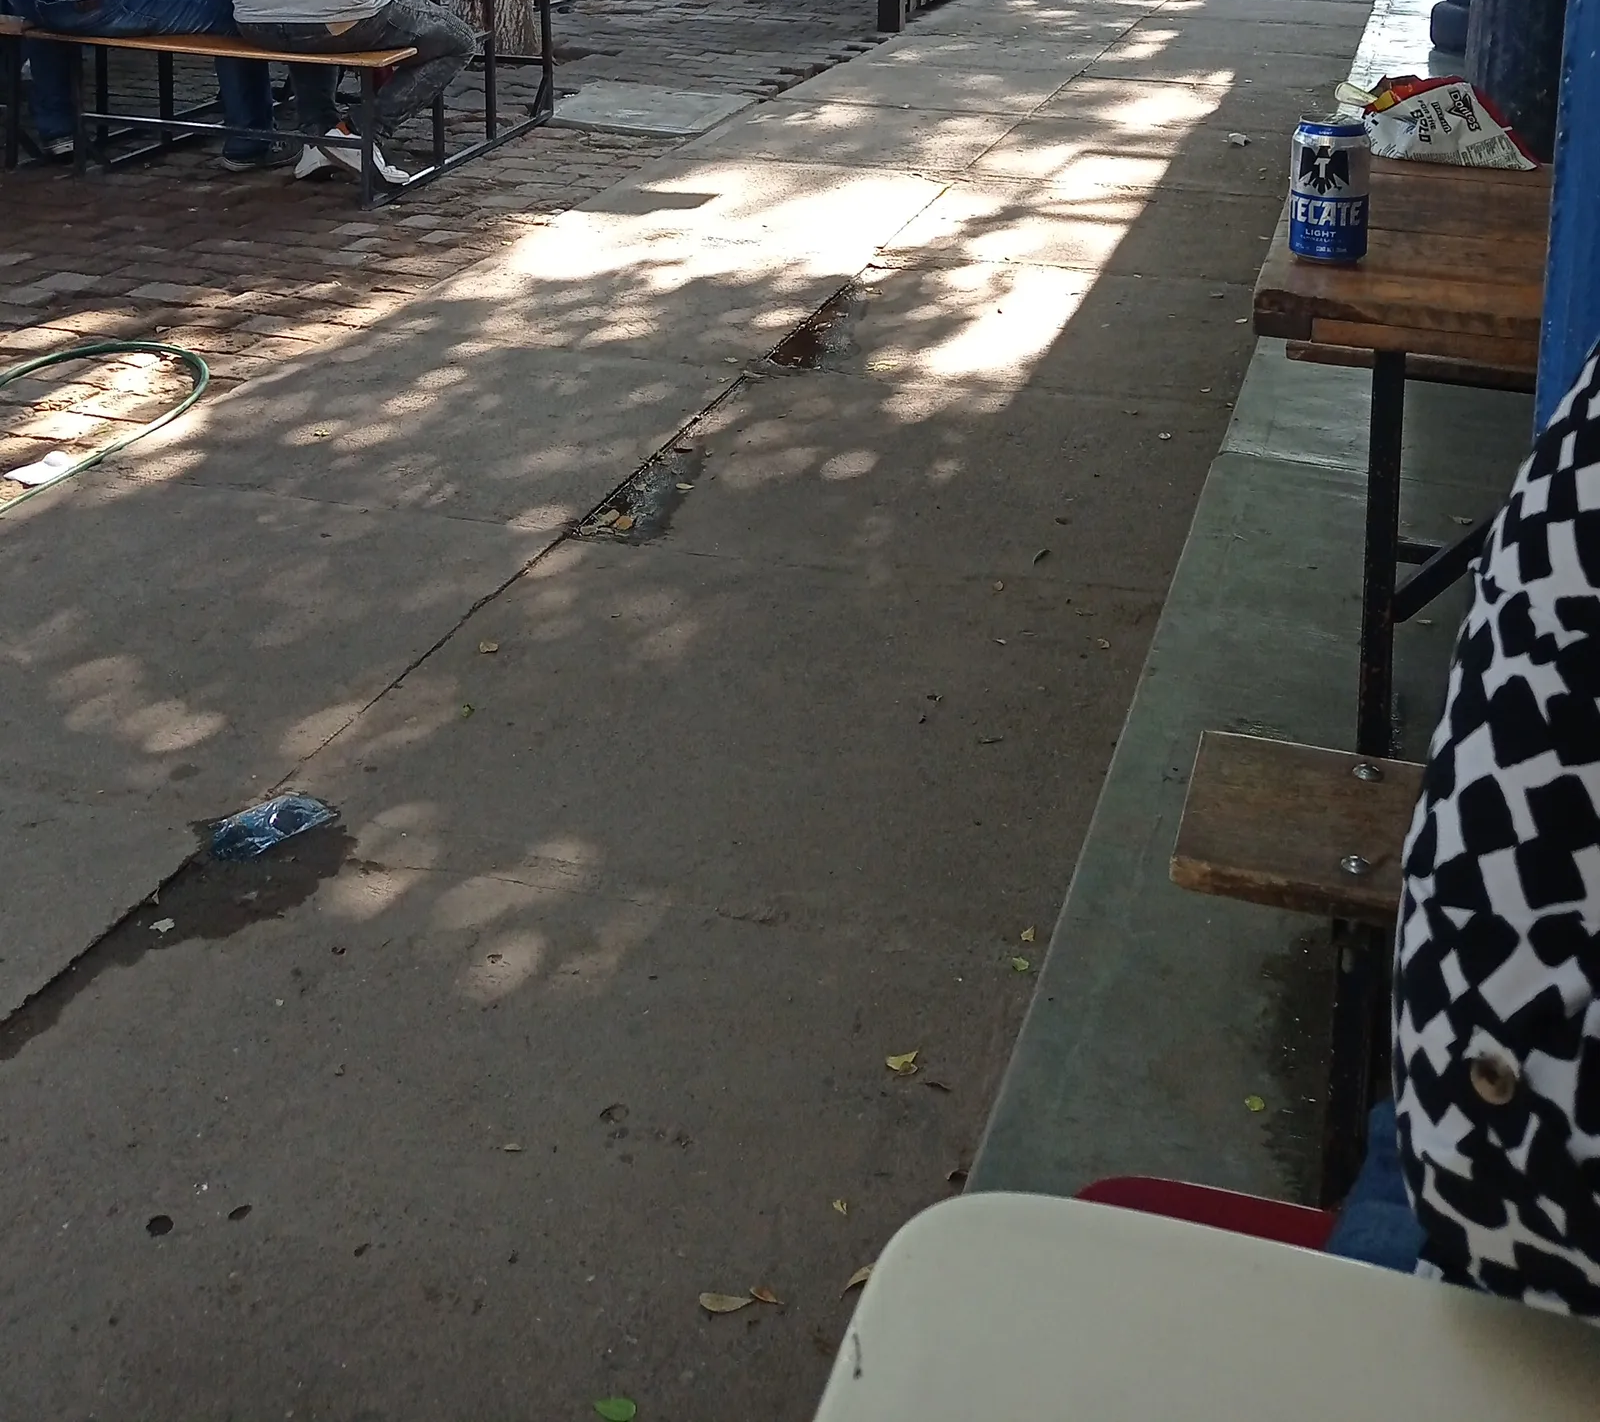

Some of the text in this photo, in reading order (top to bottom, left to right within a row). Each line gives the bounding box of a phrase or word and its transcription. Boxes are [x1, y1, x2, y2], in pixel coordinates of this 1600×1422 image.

[1449, 89, 1482, 132] Doritos
[1291, 195, 1362, 227] TECATE
[1305, 228, 1337, 238] LIGHT
